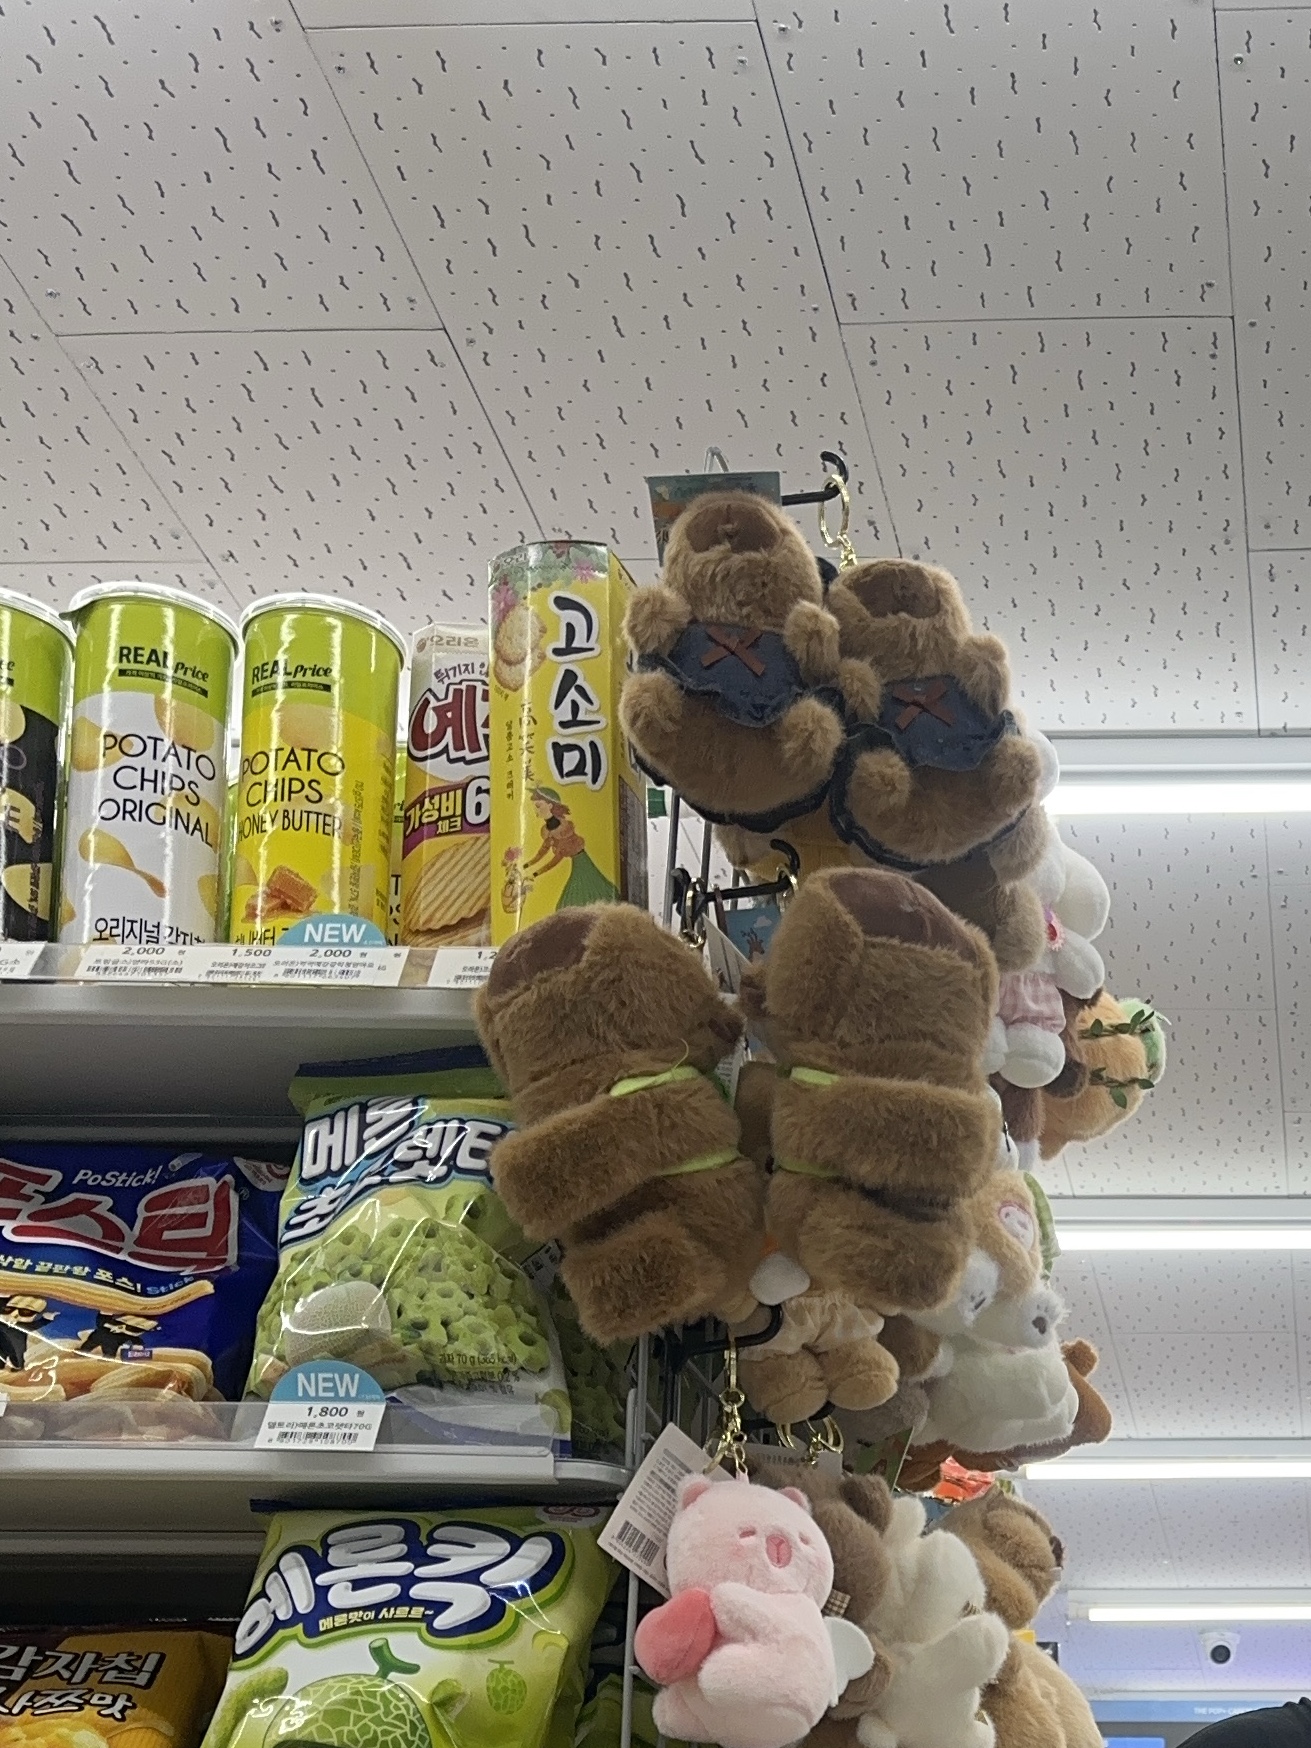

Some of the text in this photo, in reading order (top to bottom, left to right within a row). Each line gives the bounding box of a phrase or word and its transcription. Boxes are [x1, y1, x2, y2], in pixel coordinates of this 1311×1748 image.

[429, 634, 480, 648] 오리온
[118, 646, 209, 682] REAL Price
[252, 659, 333, 684] REAL Price
[433, 662, 476, 685] 튀기지
[550, 594, 602, 786] 고소미
[408, 683, 490, 756] 예
[102, 733, 216, 780] POTATO
[241, 747, 345, 782] POTATO
[113, 765, 201, 806] CHIPS
[246, 777, 323, 807] CHIPS
[98, 799, 213, 847] ORIGINAL
[238, 809, 342, 841] HONEY BUTTER
[404, 789, 463, 837] 가성비
[436, 818, 463, 835] 체크
[93, 916, 161, 944] 오리지널
[303, 922, 367, 943] NEW
[122, 947, 165, 956] 2,000
[231, 947, 272, 957] 1,500
[308, 948, 352, 958] 2,000
[72, 1164, 163, 1188] PoStick!
[93, 1268, 142, 1293] 포스!
[297, 1372, 360, 1398] NEW
[307, 1406, 349, 1418] 1,800
[235, 1523, 553, 1654] 메론킥
[318, 1610, 375, 1631] 메론맛이
[0, 1646, 163, 1688] 감자칩
